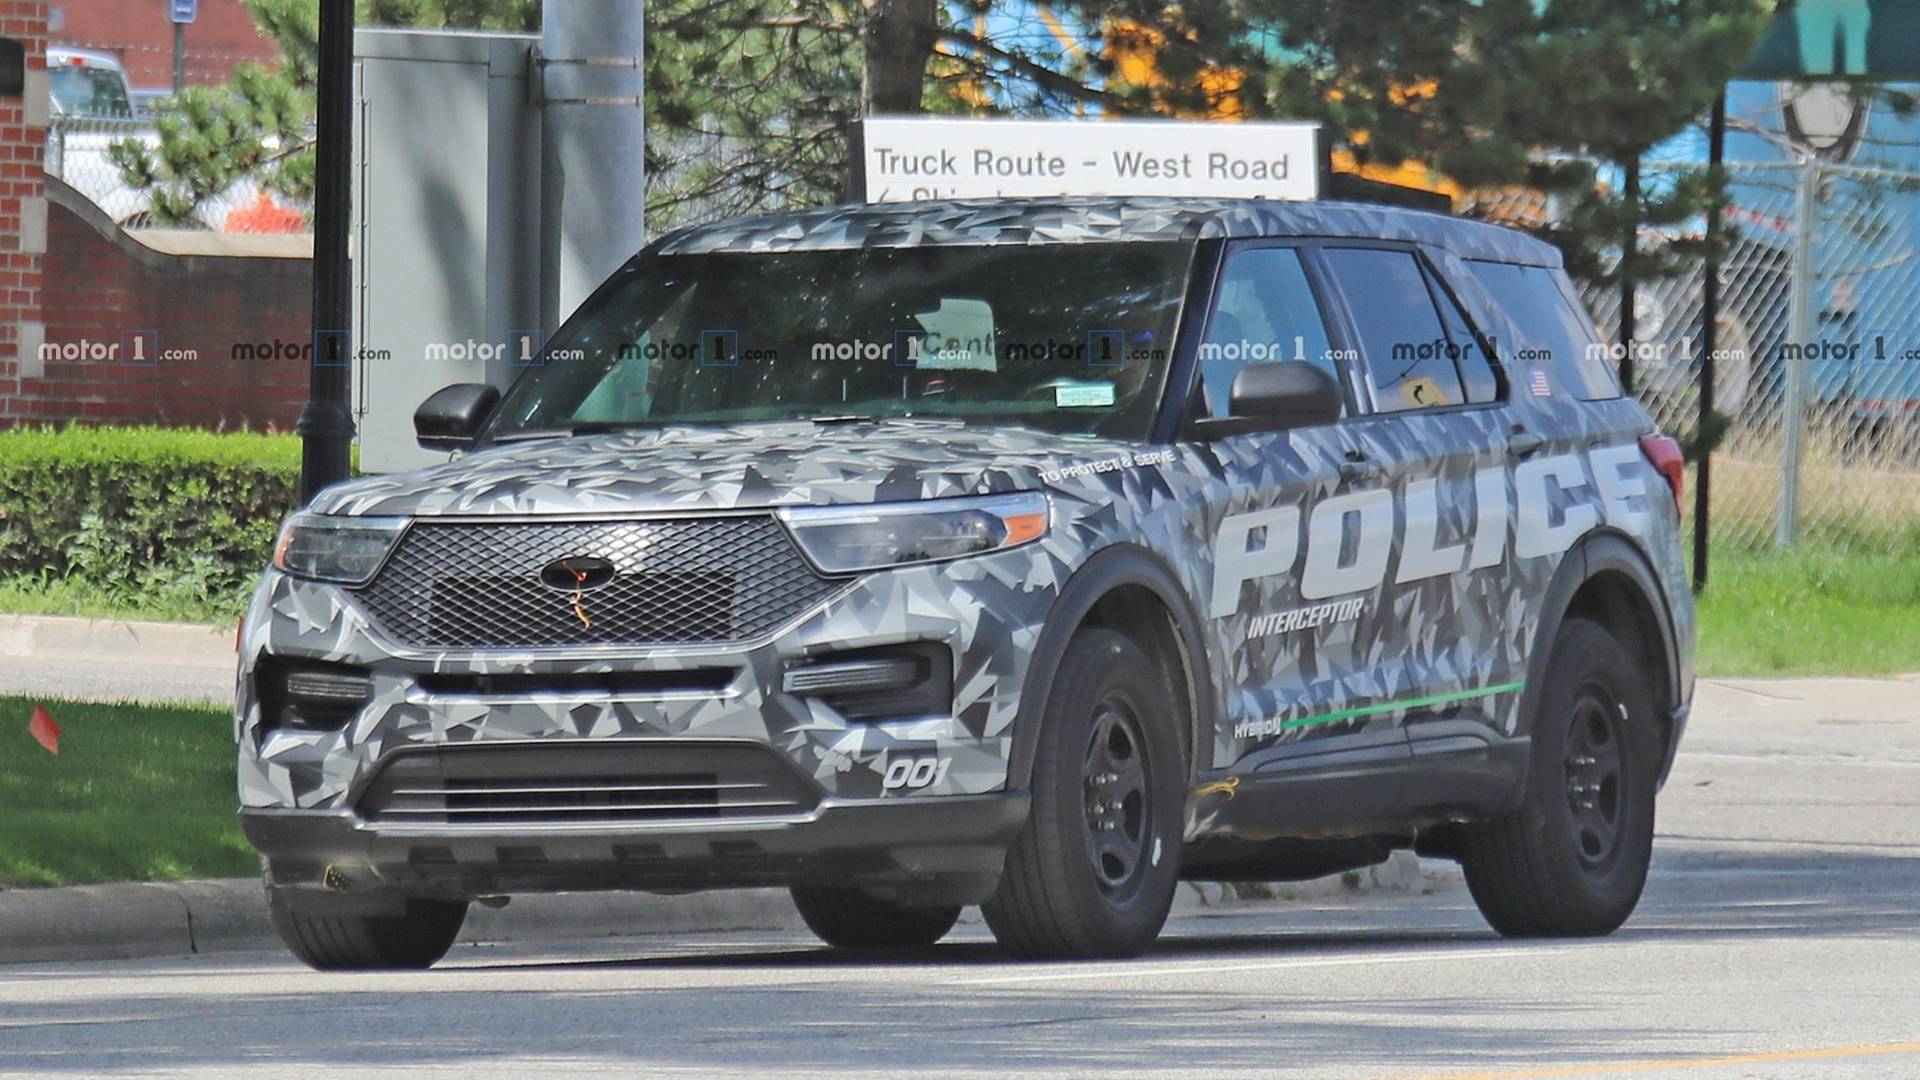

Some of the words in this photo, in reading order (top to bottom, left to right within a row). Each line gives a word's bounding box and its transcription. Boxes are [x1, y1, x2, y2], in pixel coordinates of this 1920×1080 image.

[873, 148, 957, 176] Truck
[973, 149, 1066, 177] Route
[1113, 150, 1192, 179] West
[1208, 153, 1289, 181] Road
[1038, 471, 1061, 484] TO
[1060, 457, 1123, 479] PROTECT
[1120, 455, 1133, 468] &
[1133, 449, 1177, 467] SERVE
[1210, 444, 1648, 619] POLICE
[1247, 598, 1364, 640] INTERCEPTOR
[882, 757, 953, 788] 001
